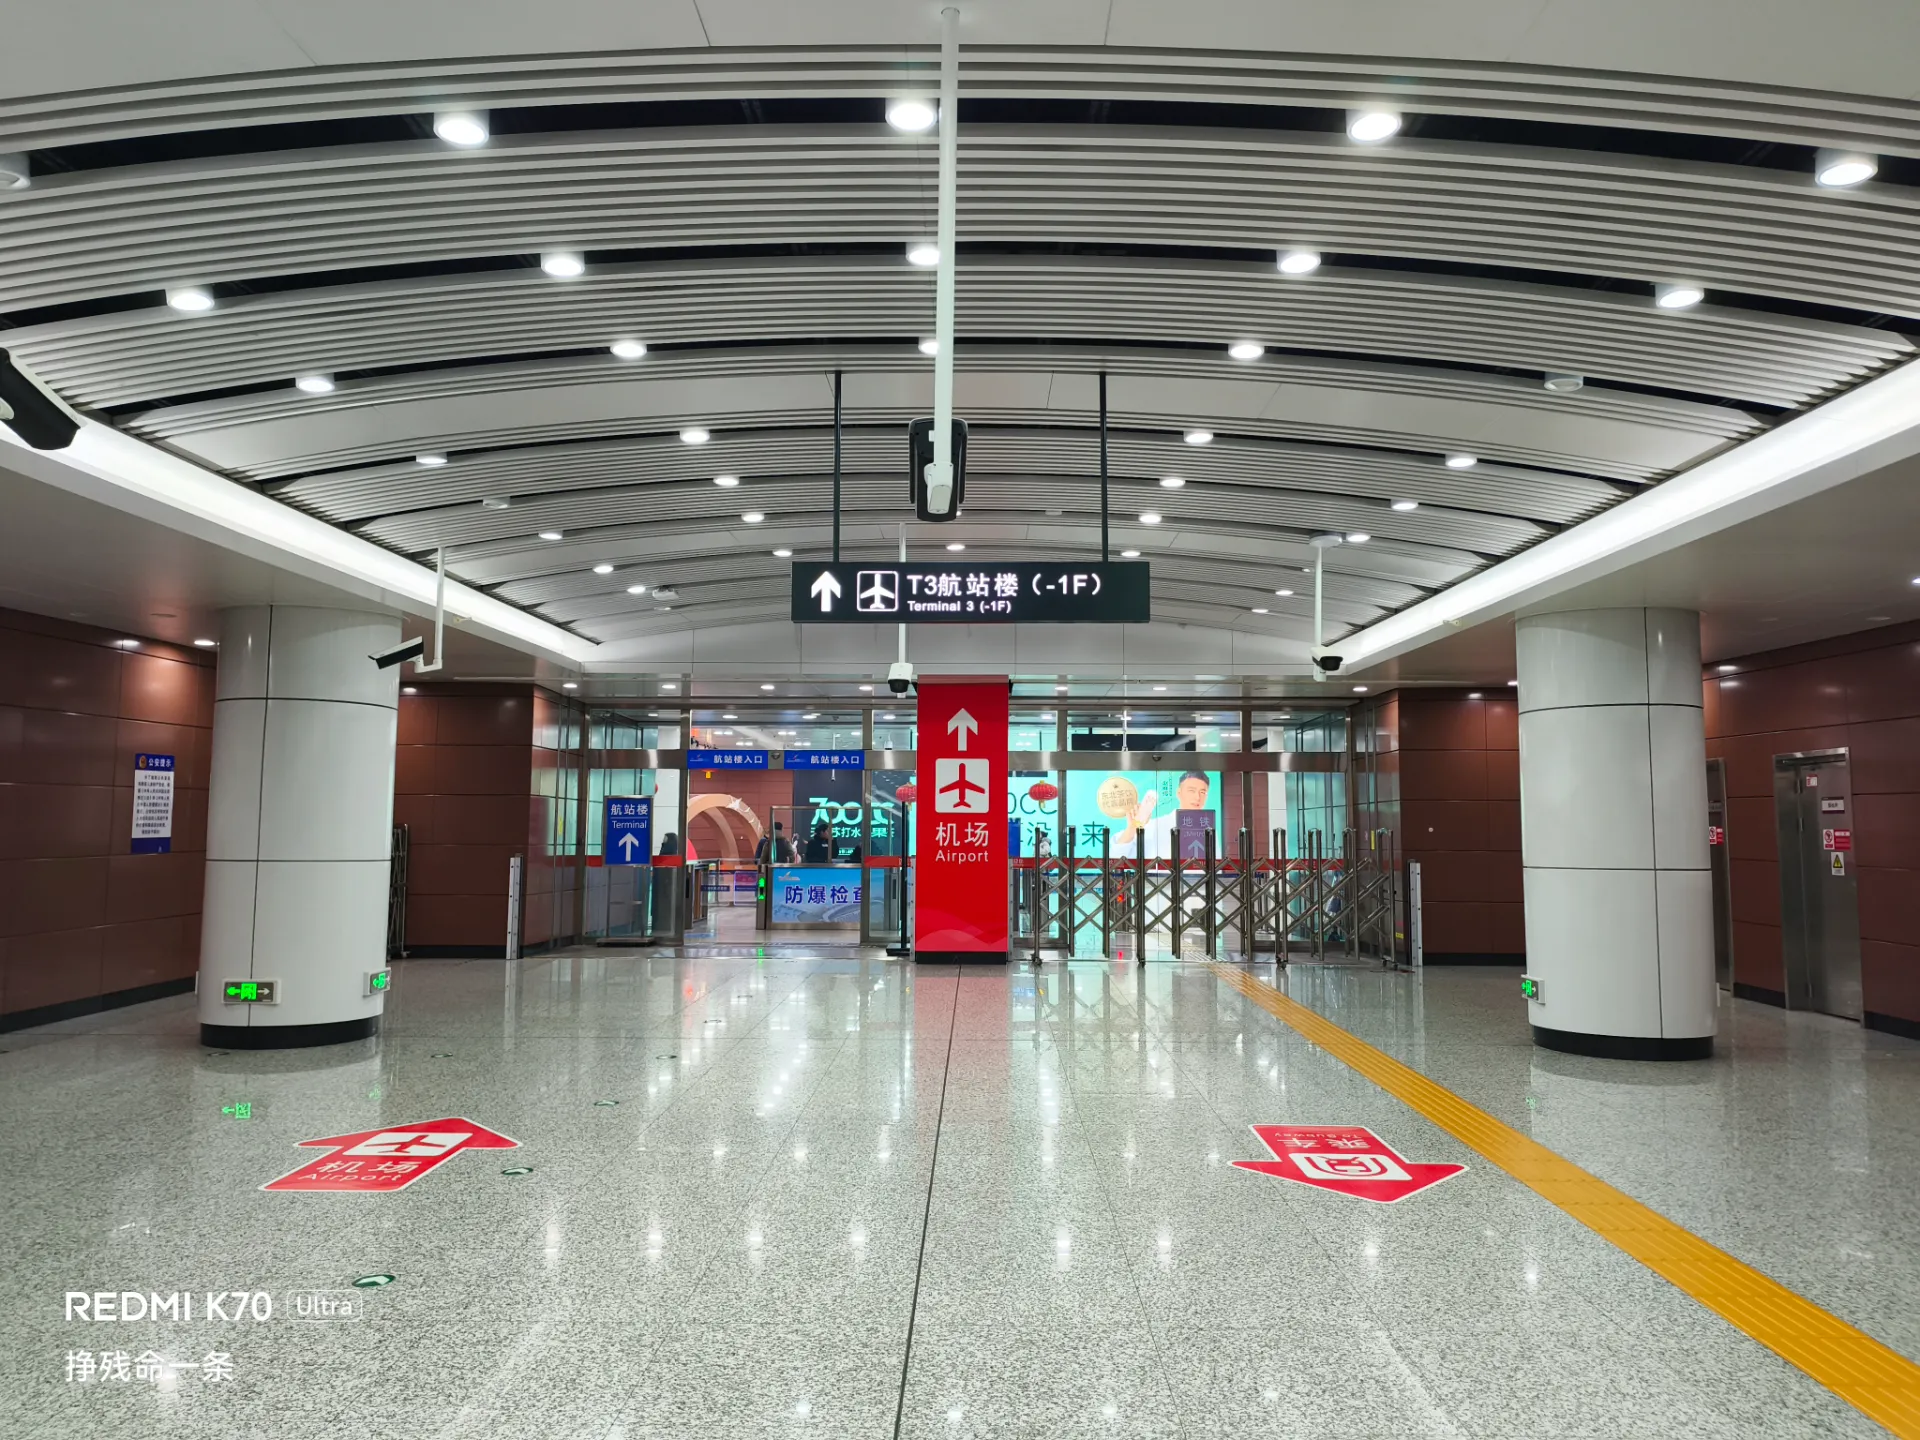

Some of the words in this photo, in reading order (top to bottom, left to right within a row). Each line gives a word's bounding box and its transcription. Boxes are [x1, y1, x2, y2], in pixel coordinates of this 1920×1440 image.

[907, 600, 961, 612] Terminal
[966, 600, 975, 612] 3
[980, 600, 1012, 613] (-1F)
[148, 758, 172, 768] 公安提示
[713, 754, 763, 764] 航站楼入口
[810, 754, 860, 764] 航站楼入口
[610, 803, 648, 816] 航站楼
[612, 820, 647, 829] Terminal
[1182, 815, 1210, 827] 地铁
[935, 822, 989, 847] 机场
[935, 849, 989, 865] Airport
[316, 1160, 422, 1173] 机场
[298, 1173, 402, 1182] Airport
